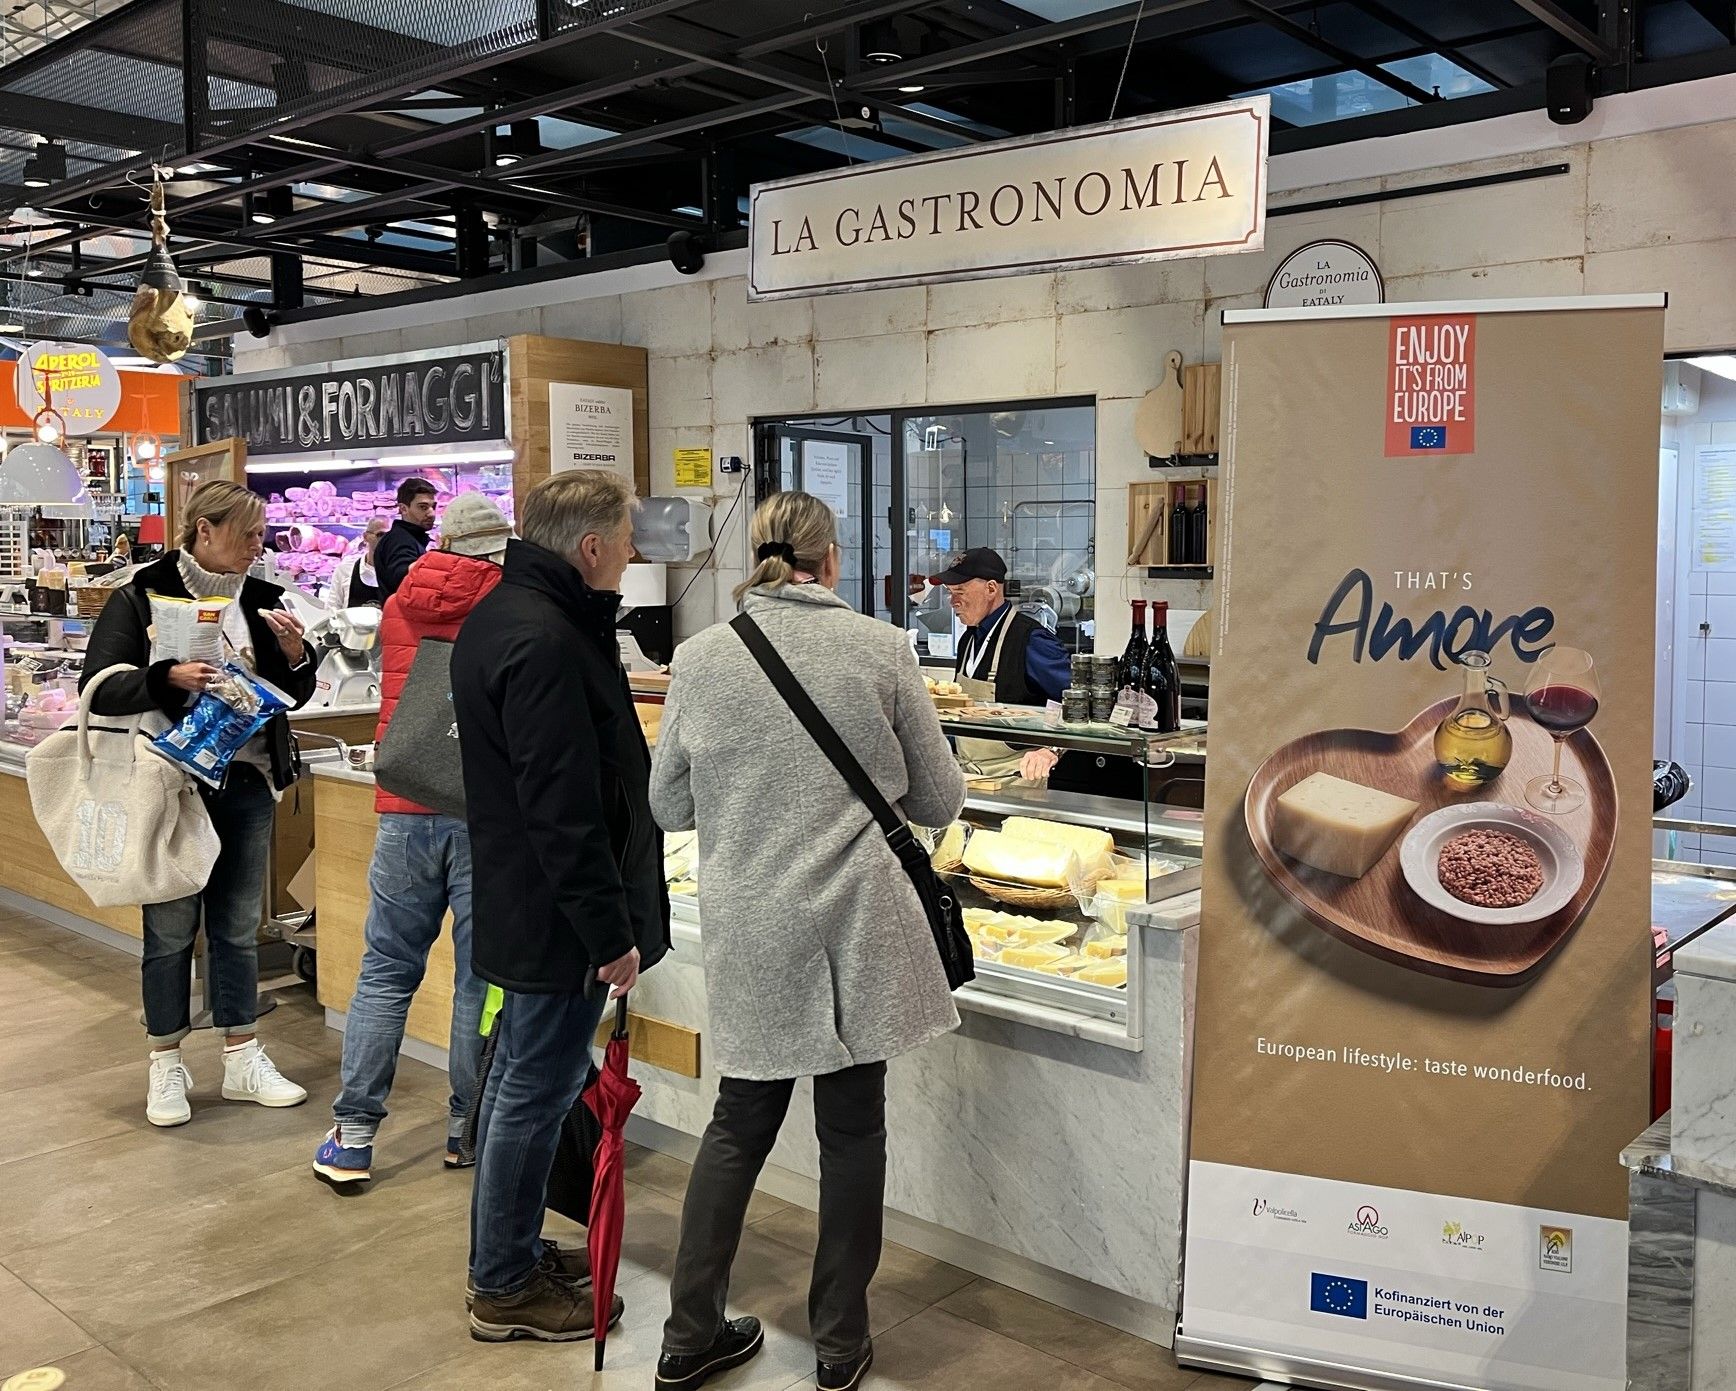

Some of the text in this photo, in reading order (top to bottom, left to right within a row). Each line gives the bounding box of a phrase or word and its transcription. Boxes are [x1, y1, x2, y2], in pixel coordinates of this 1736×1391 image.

[771, 155, 1235, 256] LA GASTRONOMIA
[1317, 261, 1331, 270] LA
[1279, 267, 1369, 289] Gastronomia
[1302, 295, 1345, 308] EATALY
[1395, 324, 1470, 364] ENJOY
[34, 352, 101, 371] APEROL
[36, 373, 101, 394] SRITZERIA
[1395, 364, 1467, 391] IT'S FROM
[575, 404, 612, 415] BIZERBA
[1393, 390, 1467, 423] EUROPE
[573, 453, 616, 462] BIZERBA
[1394, 571, 1473, 591] THAT'S
[1306, 567, 1556, 671] Amore
[72, 799, 128, 873] 10
[1257, 1037, 1593, 1091] European lifestyle: taste wonderfood.
[1347, 1221, 1389, 1236] ASIAGO
[1375, 1287, 1505, 1319] Kofinanziert von der
[1374, 1303, 1505, 1335] Europäischen Union
